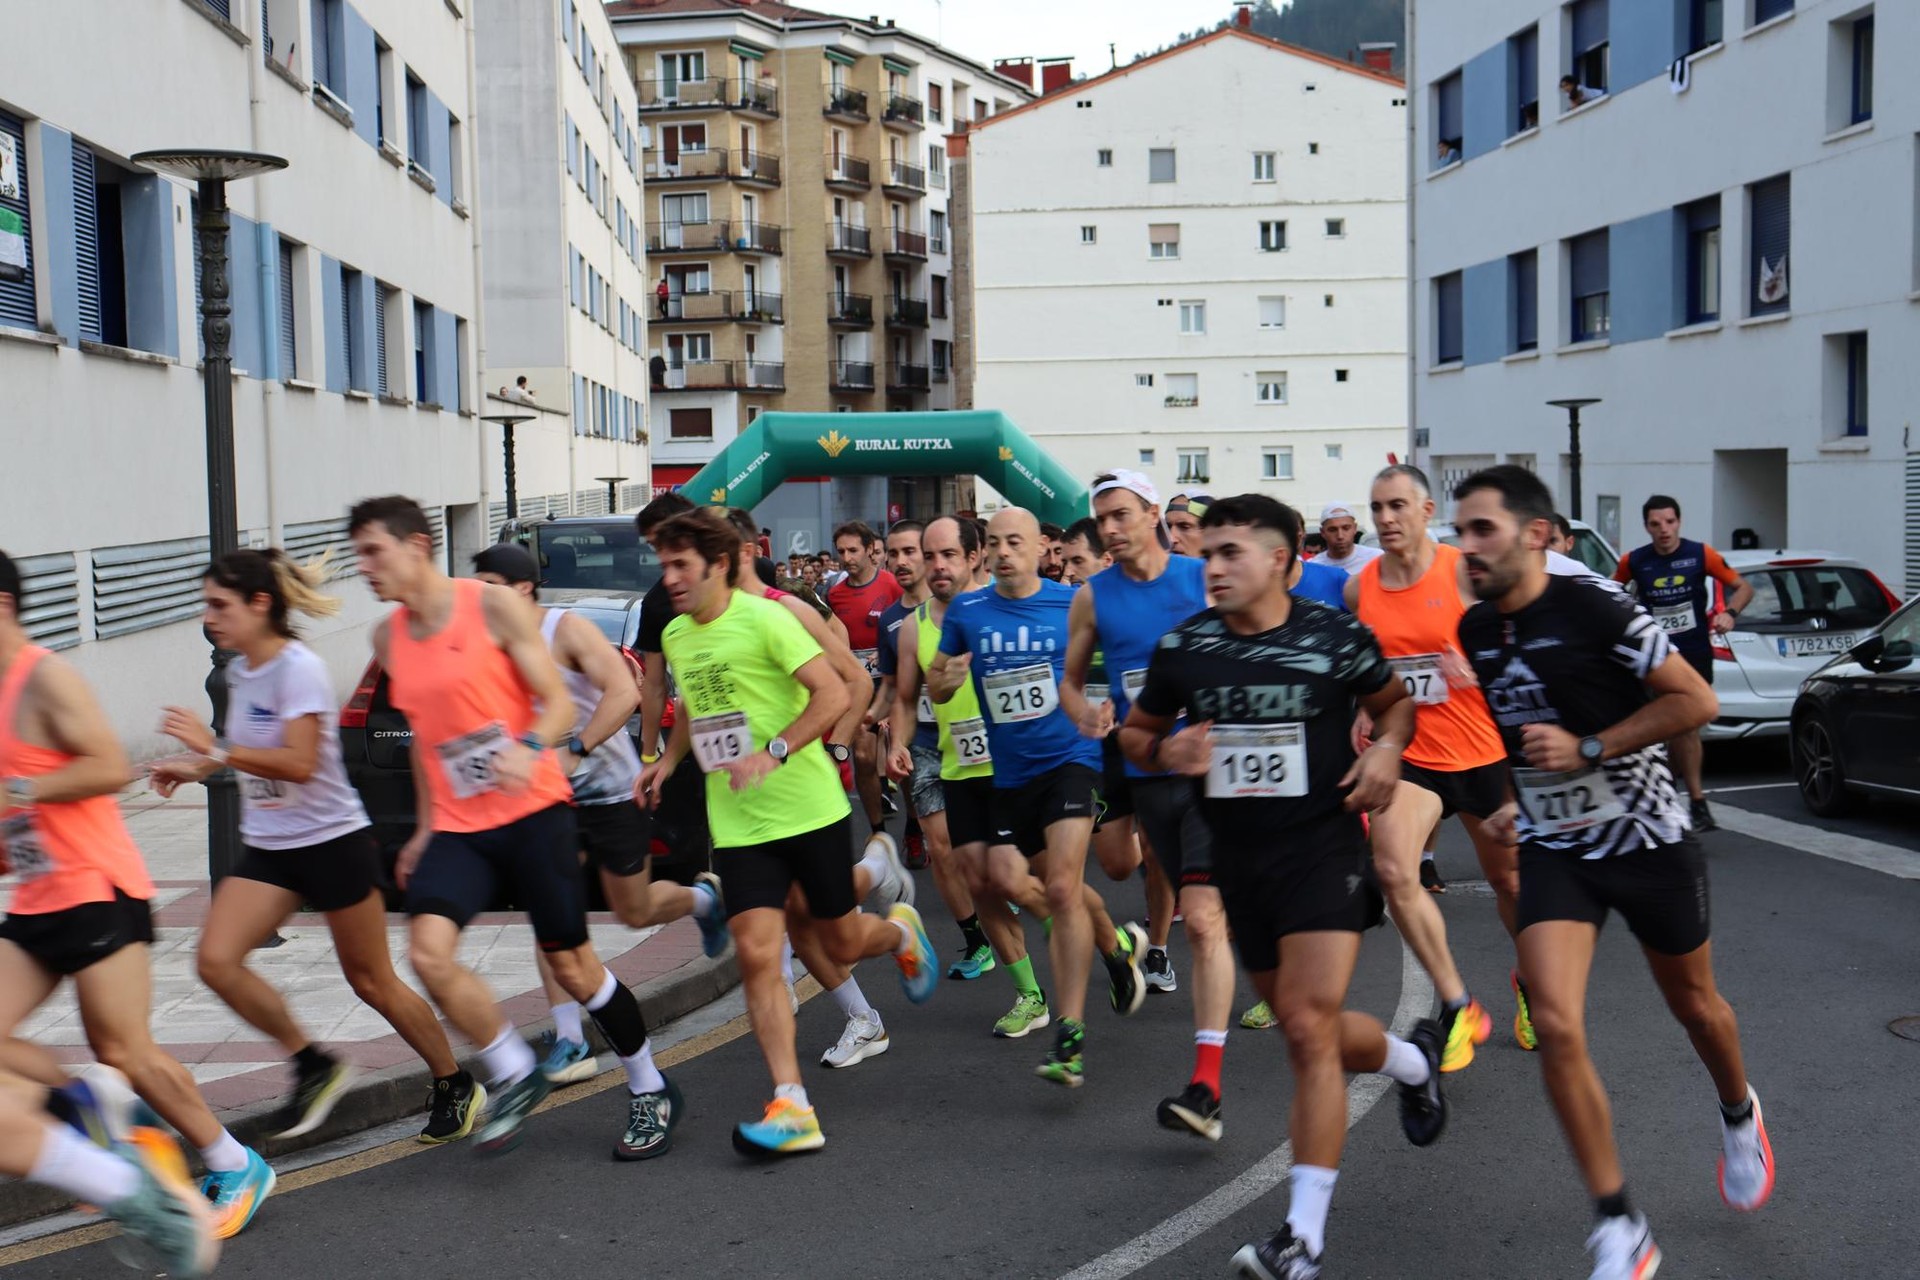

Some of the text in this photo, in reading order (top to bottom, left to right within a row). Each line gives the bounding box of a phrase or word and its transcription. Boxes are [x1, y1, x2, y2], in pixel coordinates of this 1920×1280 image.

[855, 438, 953, 451] RURAL KUTXA
[727, 451, 771, 491] RURAL KUTXA
[1011, 460, 1055, 499] RURAL KUTXA
[1661, 615, 1689, 629] 282
[1790, 636, 1853, 652] 1782 KSB
[999, 686, 1044, 713] 218
[702, 734, 741, 762] 119
[960, 733, 988, 757] 23
[1221, 753, 1286, 784] 198
[1537, 785, 1599, 820] 272
